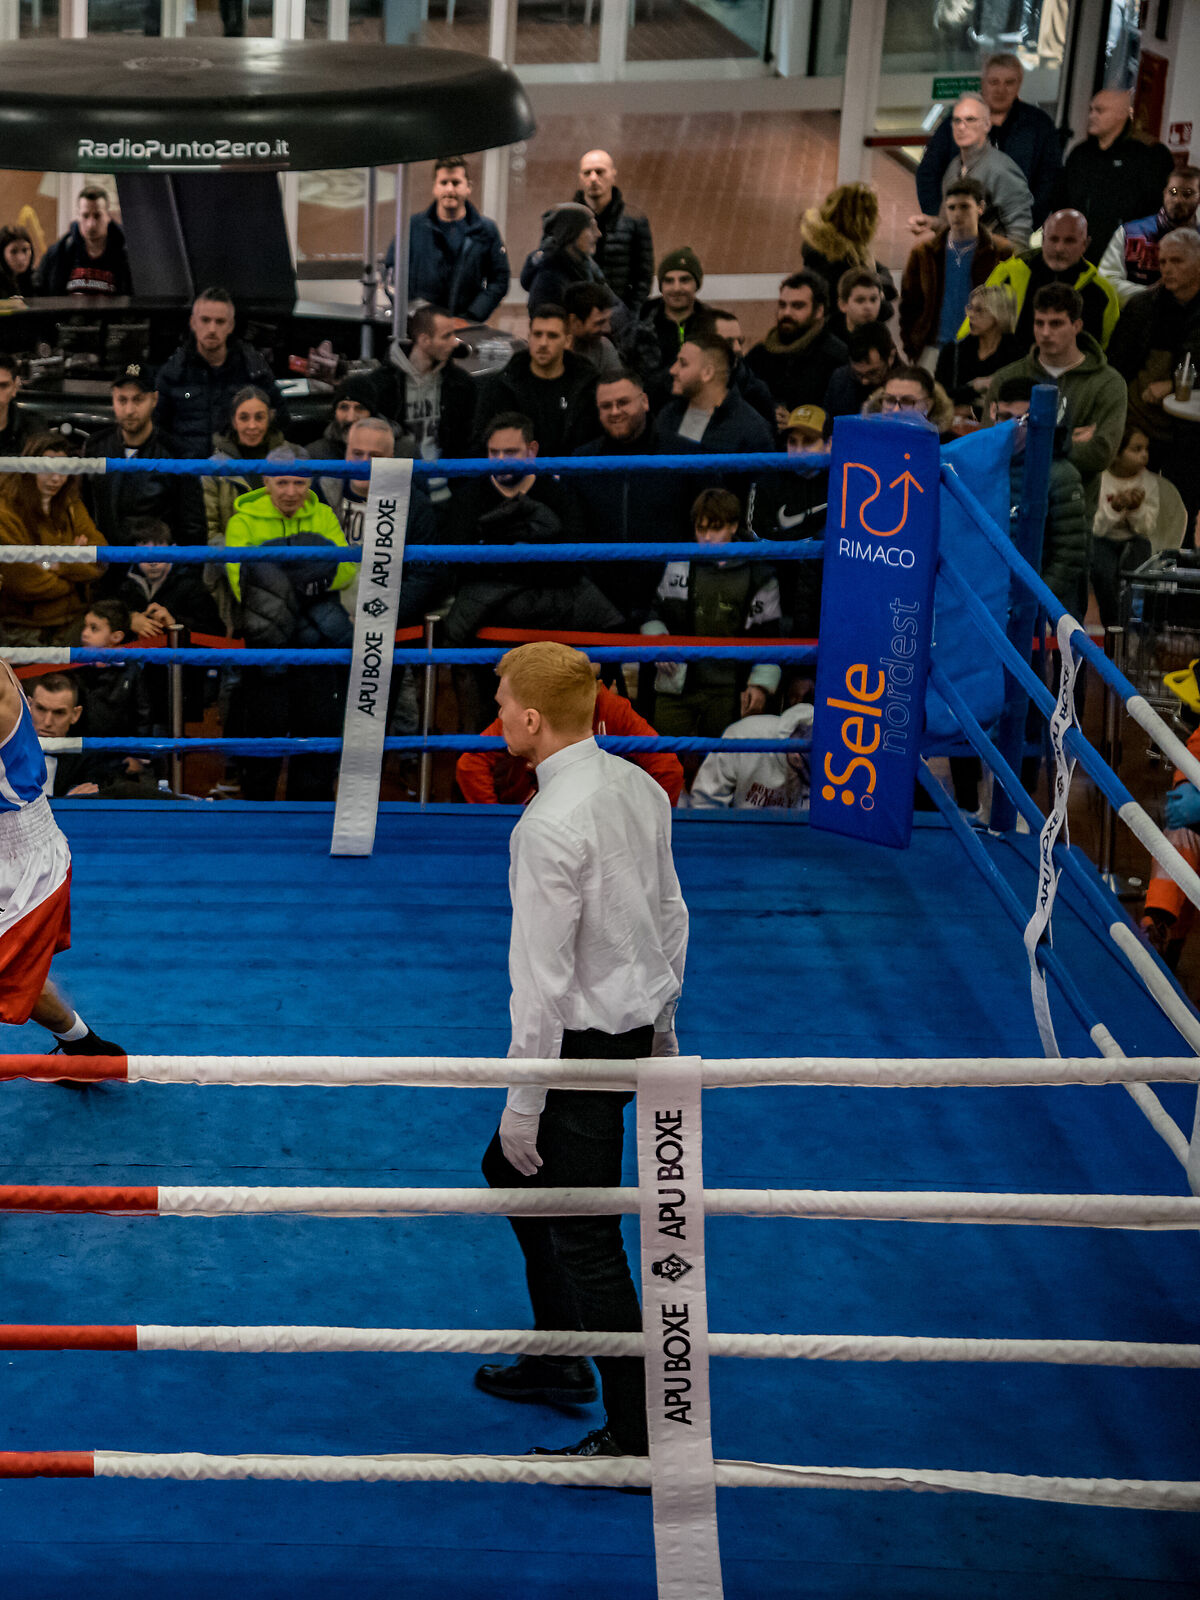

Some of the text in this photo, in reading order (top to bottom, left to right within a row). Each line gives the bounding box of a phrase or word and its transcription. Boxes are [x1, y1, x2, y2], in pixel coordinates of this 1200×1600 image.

[77, 138, 290, 158] RadioPuntoZero.it
[371, 499, 397, 588] APU BOXE
[839, 537, 915, 569] RIMACO
[357, 632, 383, 717] APU BOXE
[880, 597, 920, 754] nordest
[824, 663, 885, 794] Sele
[1041, 868, 1051, 911] APU
[655, 1109, 687, 1240] APU BOXE
[661, 1303, 693, 1425] APU BOXE
